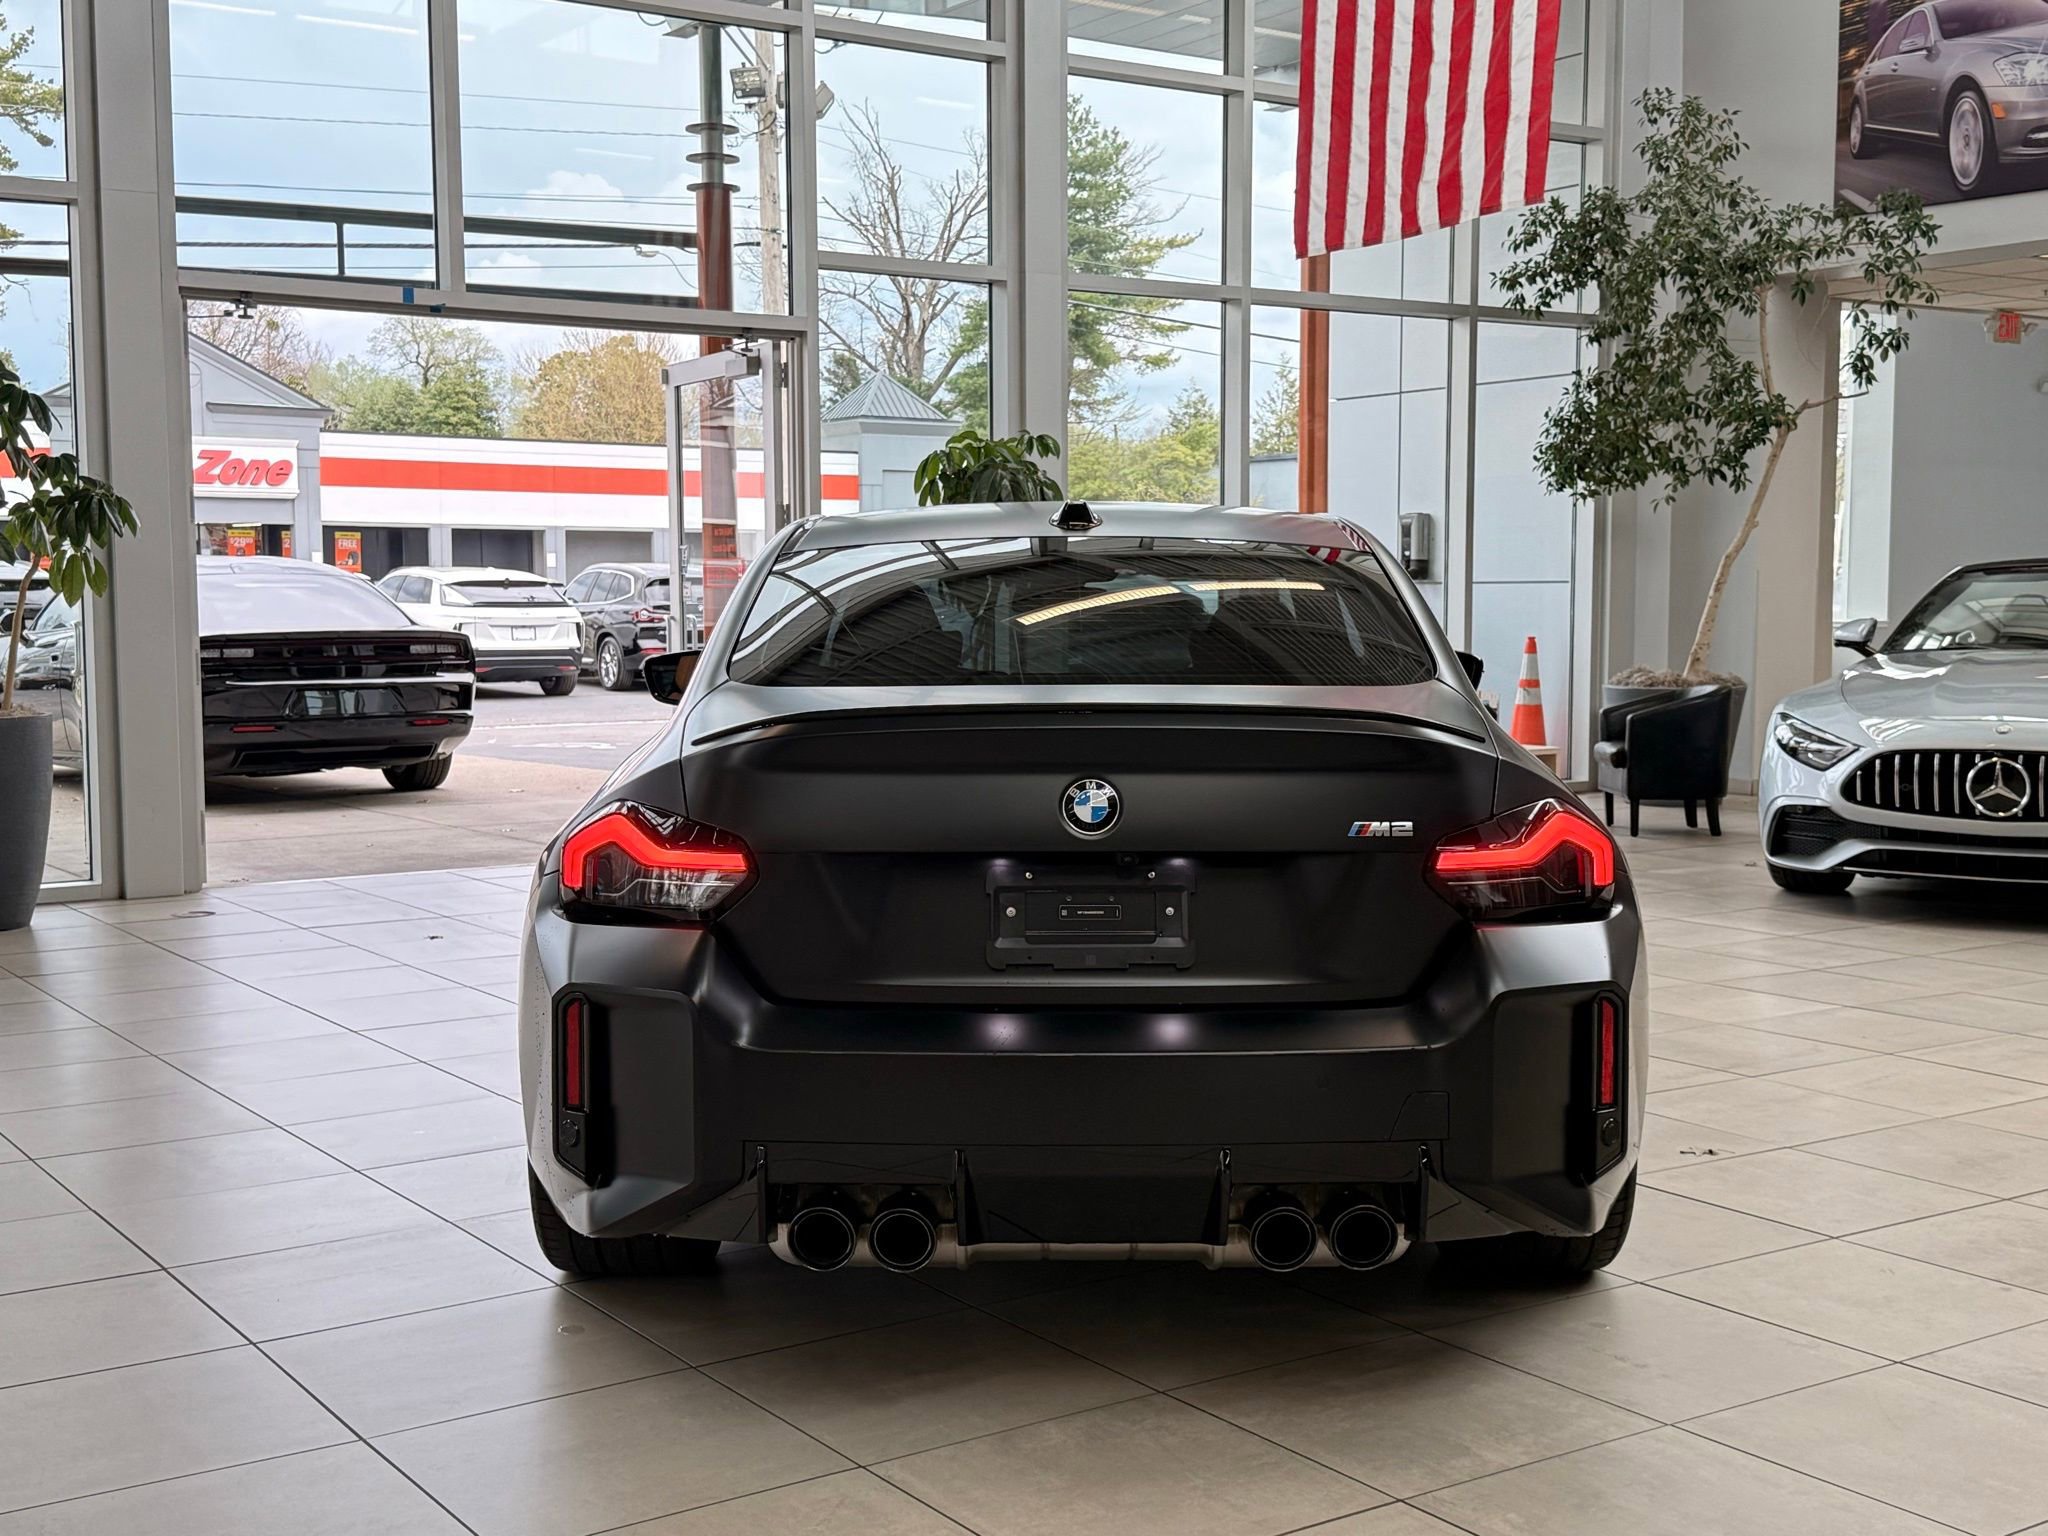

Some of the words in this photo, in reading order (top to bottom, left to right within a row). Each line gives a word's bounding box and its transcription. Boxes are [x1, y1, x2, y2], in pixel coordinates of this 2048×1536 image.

[194, 449, 293, 487] Zone
[338, 539, 358, 548] FREE
[1069, 781, 1114, 798] BMW
[1367, 821, 1413, 837] M2
